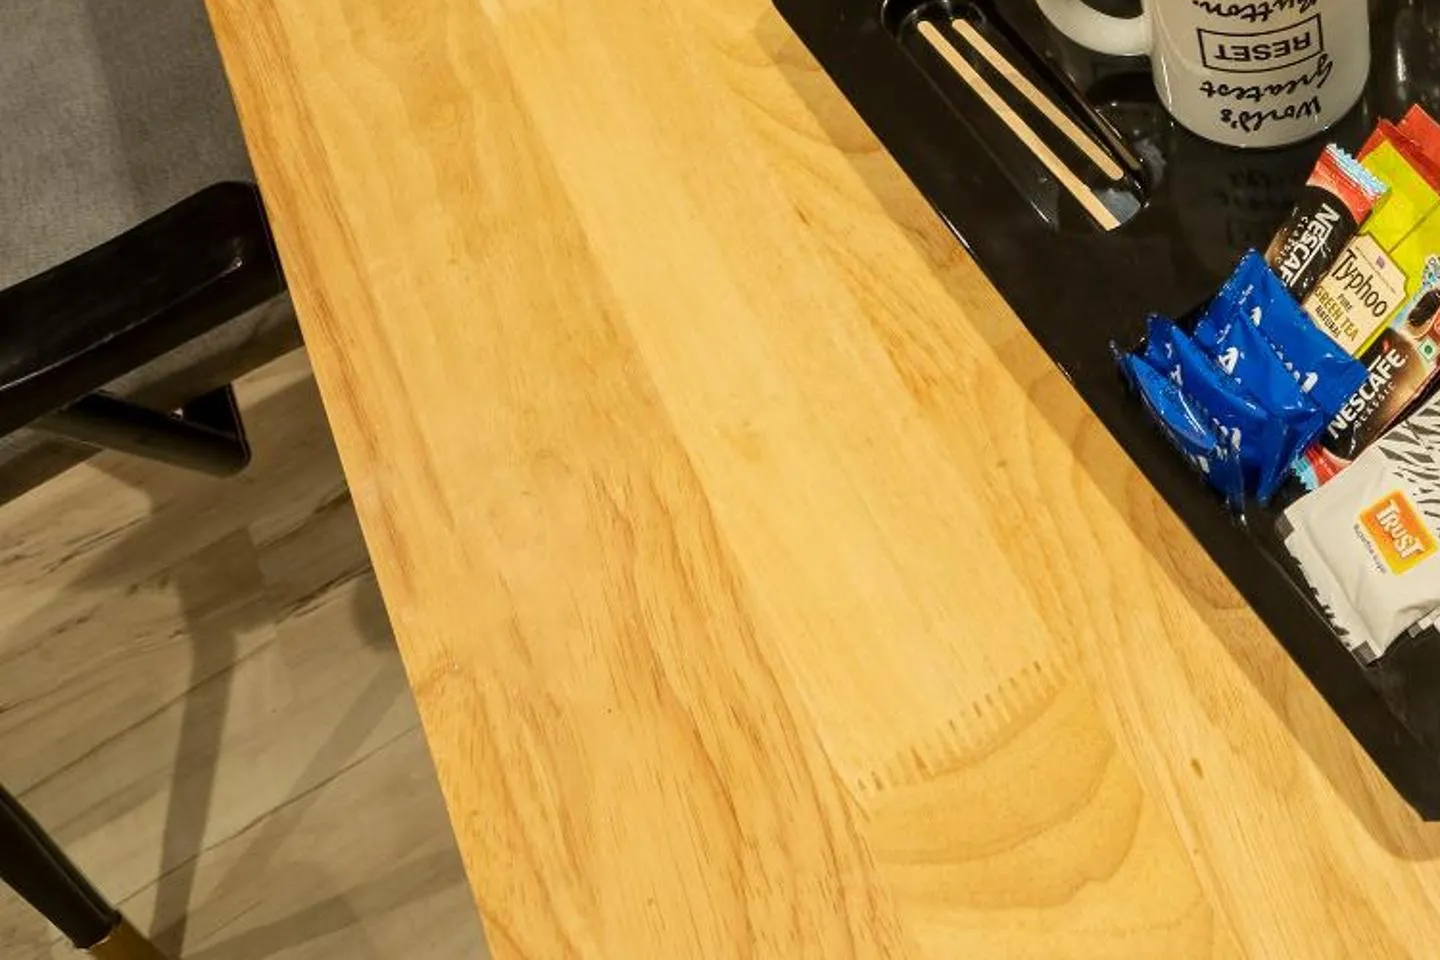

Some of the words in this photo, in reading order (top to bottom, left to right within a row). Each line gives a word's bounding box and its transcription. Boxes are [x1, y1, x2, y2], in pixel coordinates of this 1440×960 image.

[1214, 32, 1311, 62] RESET
[1200, 53, 1334, 102] Greatest
[1220, 96, 1322, 133] World's
[1281, 203, 1341, 288] NESCAF
[1341, 316, 1360, 341] TEA
